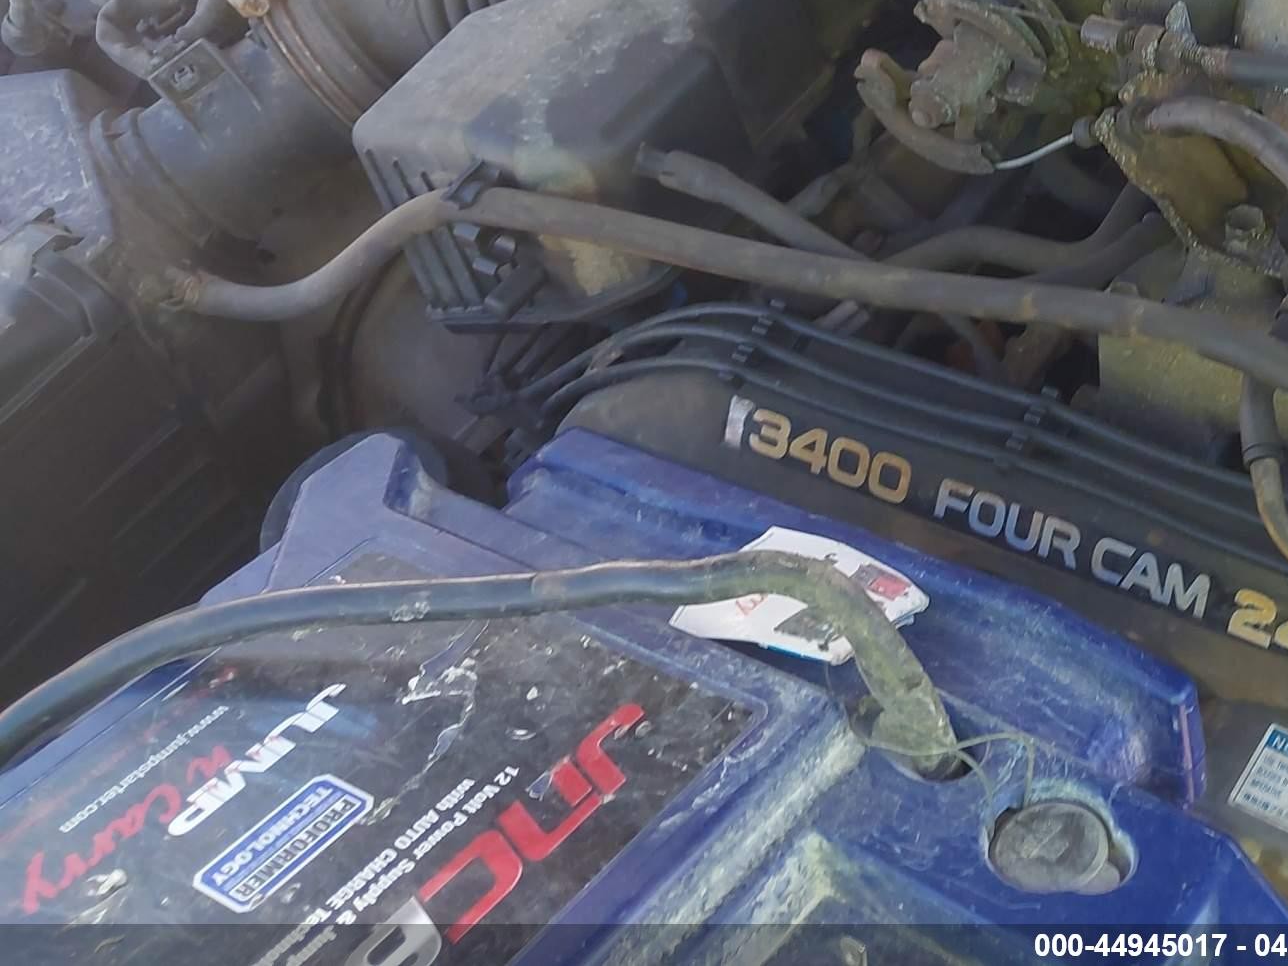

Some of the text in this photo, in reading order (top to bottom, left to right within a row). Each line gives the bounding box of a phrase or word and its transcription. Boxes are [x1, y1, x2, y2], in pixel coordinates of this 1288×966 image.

[750, 407, 912, 505] 3400
[934, 478, 1082, 570] FOUR
[1091, 537, 1213, 619] CAM
[59, 705, 229, 833] www.jumpstarter.com
[168, 683, 346, 836] JUMP
[494, 766, 520, 785] 12
[435, 778, 476, 811] with
[462, 784, 500, 814] Volt
[22, 783, 182, 915] Carry
[212, 786, 333, 886] TECHNOLOGY
[235, 793, 356, 896] PROFORMER
[394, 809, 440, 850] AUTO
[413, 811, 468, 860] Power
[325, 847, 397, 910] CHARGE
[352, 858, 416, 912] Supply
[336, 909, 357, 925] &
